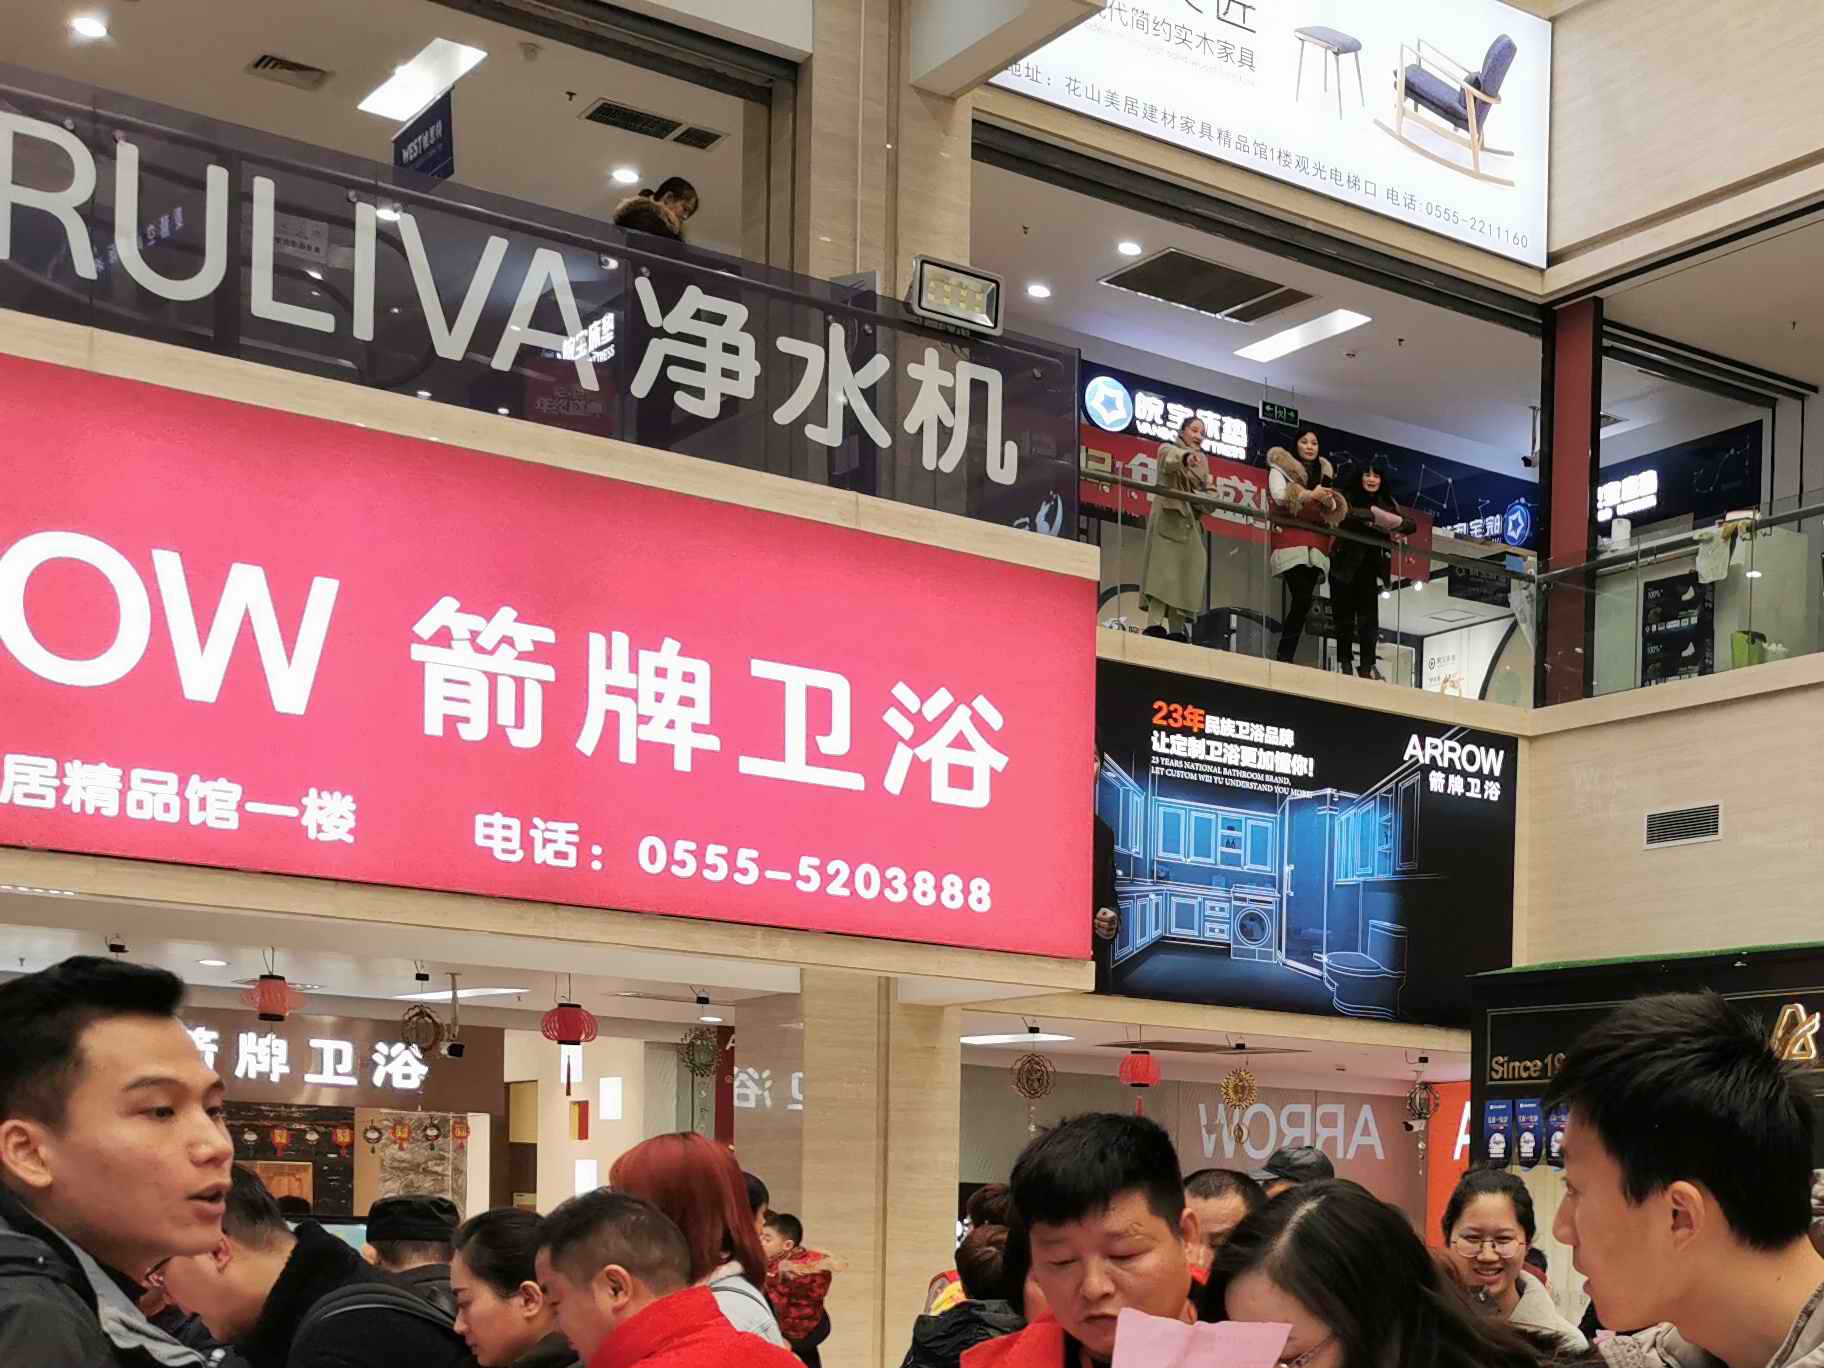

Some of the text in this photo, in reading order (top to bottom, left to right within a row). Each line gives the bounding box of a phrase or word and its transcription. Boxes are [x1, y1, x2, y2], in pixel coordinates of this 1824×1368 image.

[1099, 0, 1256, 72] 代简约实木家具
[630, 273, 1019, 487] 净水机
[409, 595, 1009, 809] 箭牌卫浴
[1160, 757, 1183, 768] YEARS
[1184, 760, 1222, 774] NATIONAL
[1165, 767, 1198, 781] CUSTOM
[1402, 734, 1505, 777] ARROW
[1, 752, 358, 844] 居精品馆一楼
[1428, 769, 1501, 801] 箭牌卫浴
[1490, 1055, 1543, 1081] Since
